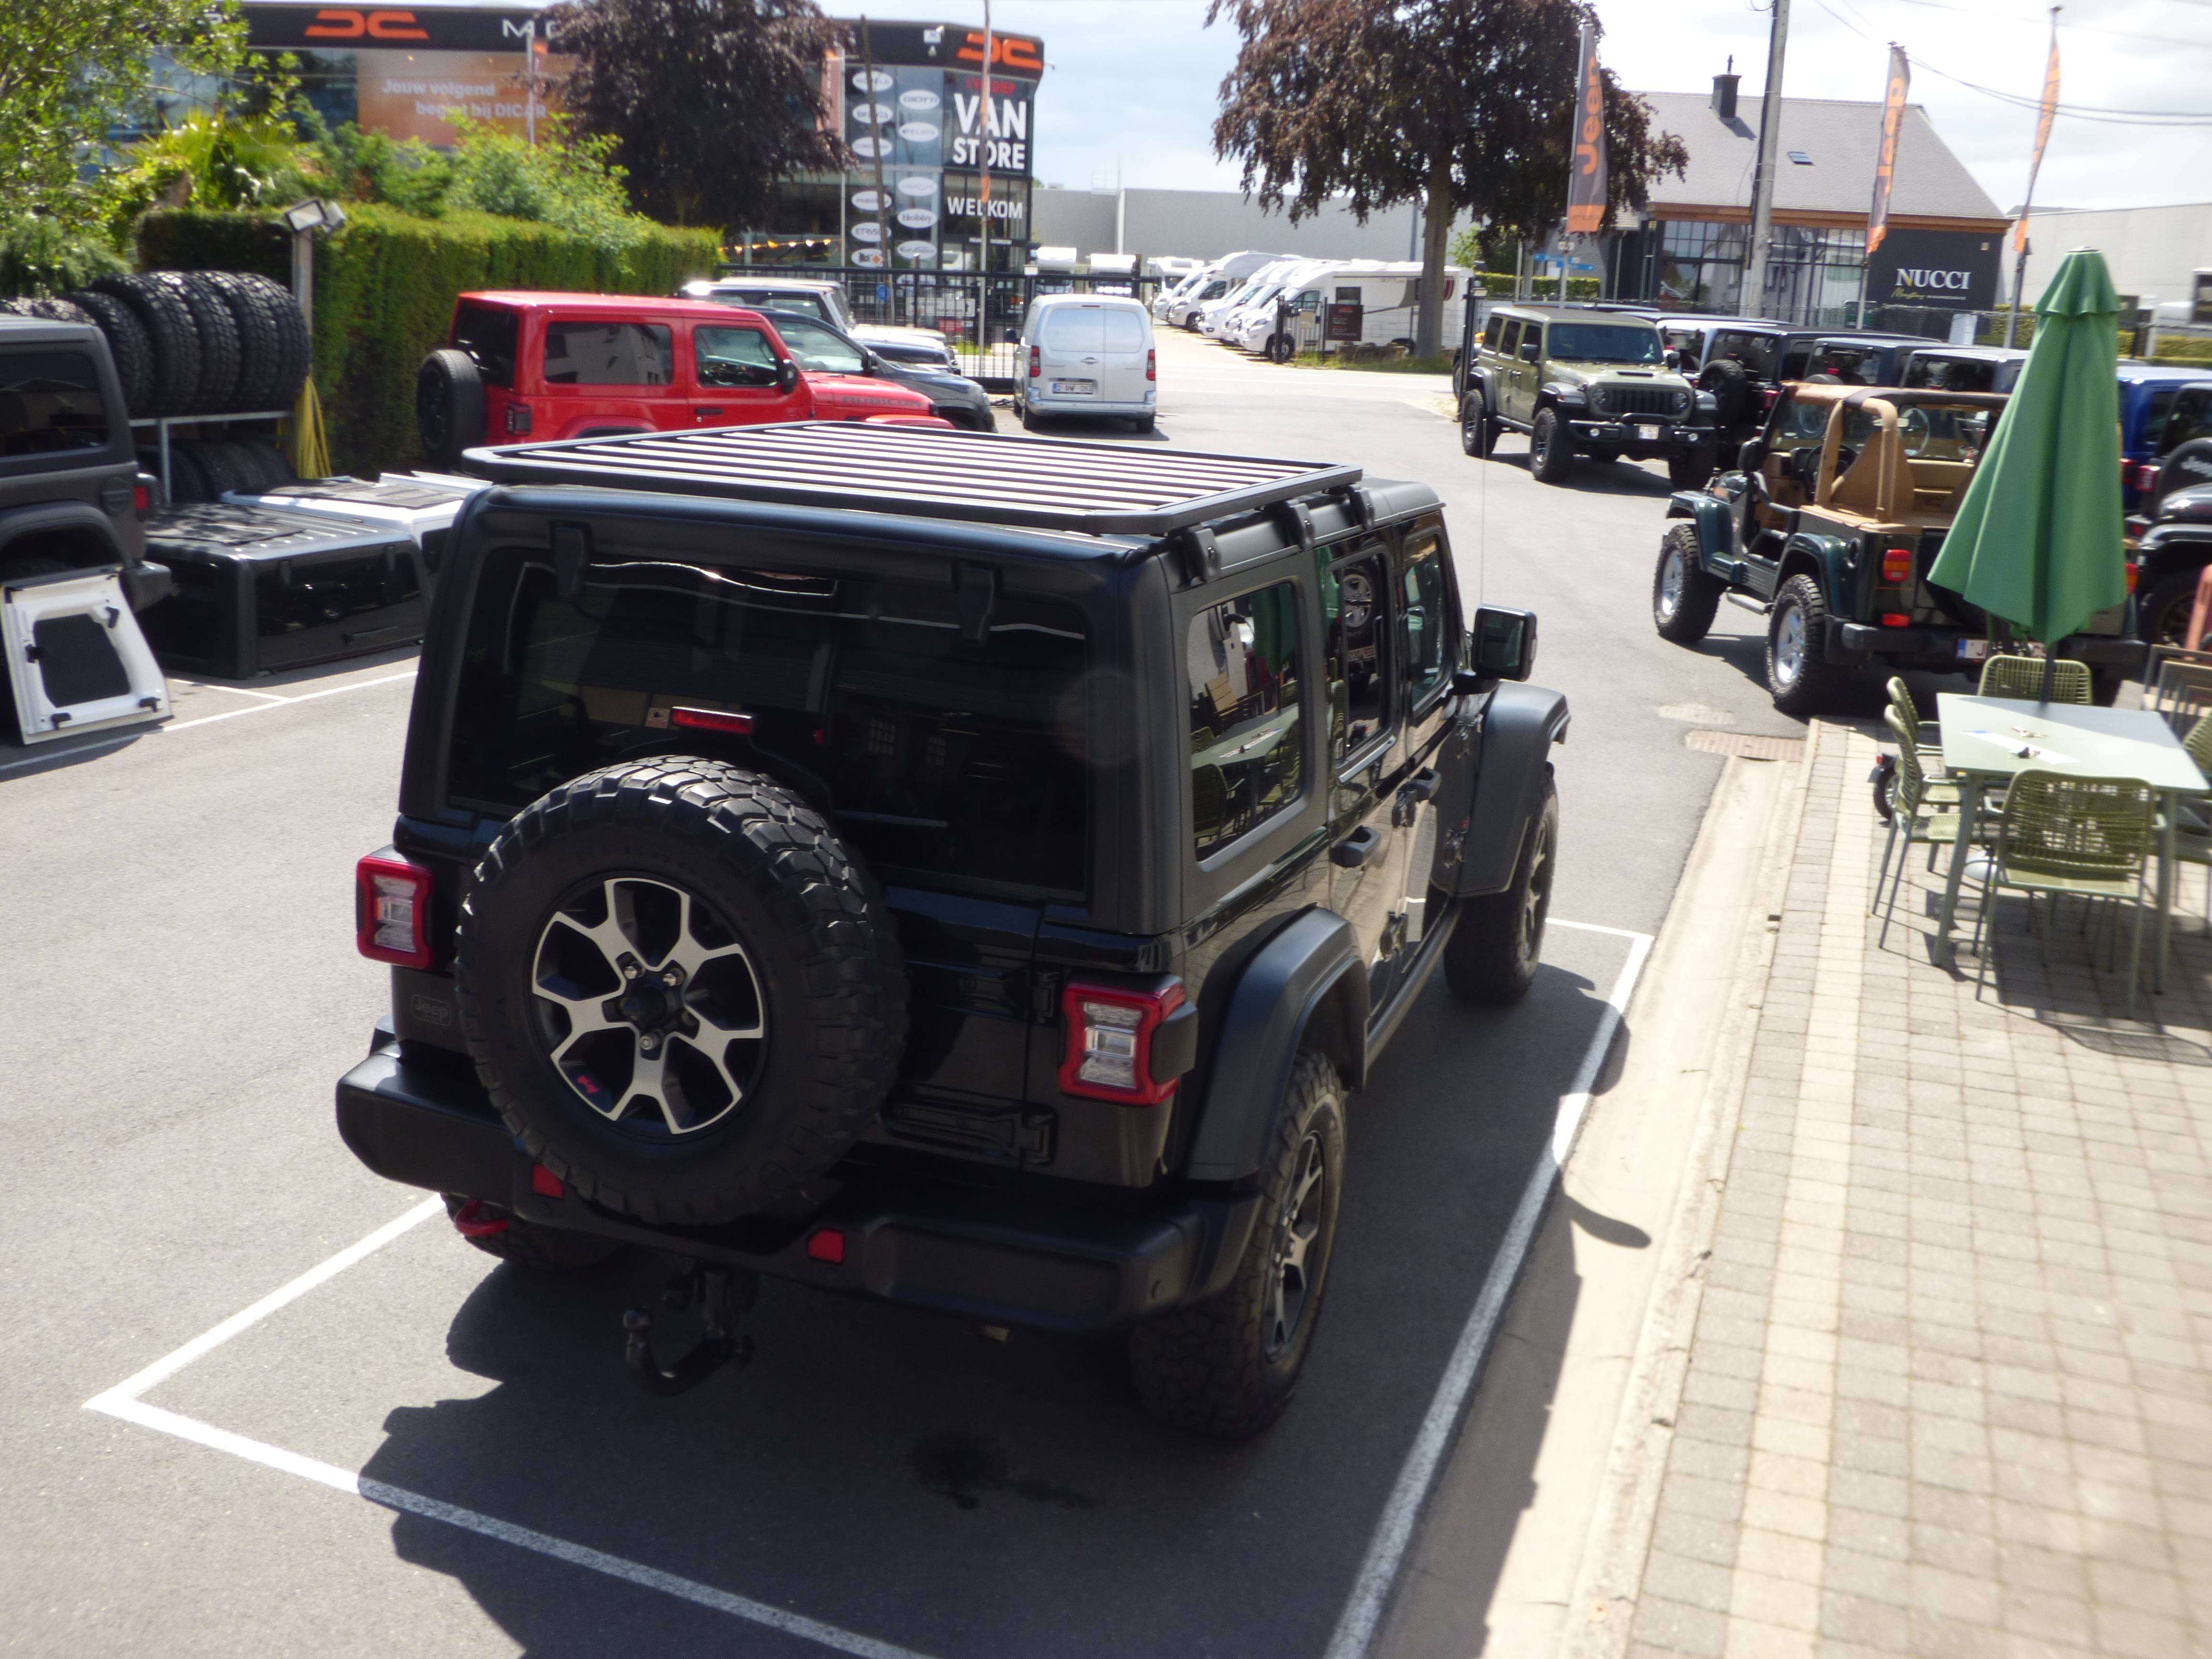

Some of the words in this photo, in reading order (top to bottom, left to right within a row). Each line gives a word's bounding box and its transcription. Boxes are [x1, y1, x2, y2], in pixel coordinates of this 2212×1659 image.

[953, 93, 1026, 140] VAN
[952, 136, 1025, 169] STORE
[902, 214, 931, 223] Hobby
[947, 196, 1023, 219] WELKOM
[1895, 268, 1972, 289] NUCCI
[843, 396, 922, 408] RUBICON
